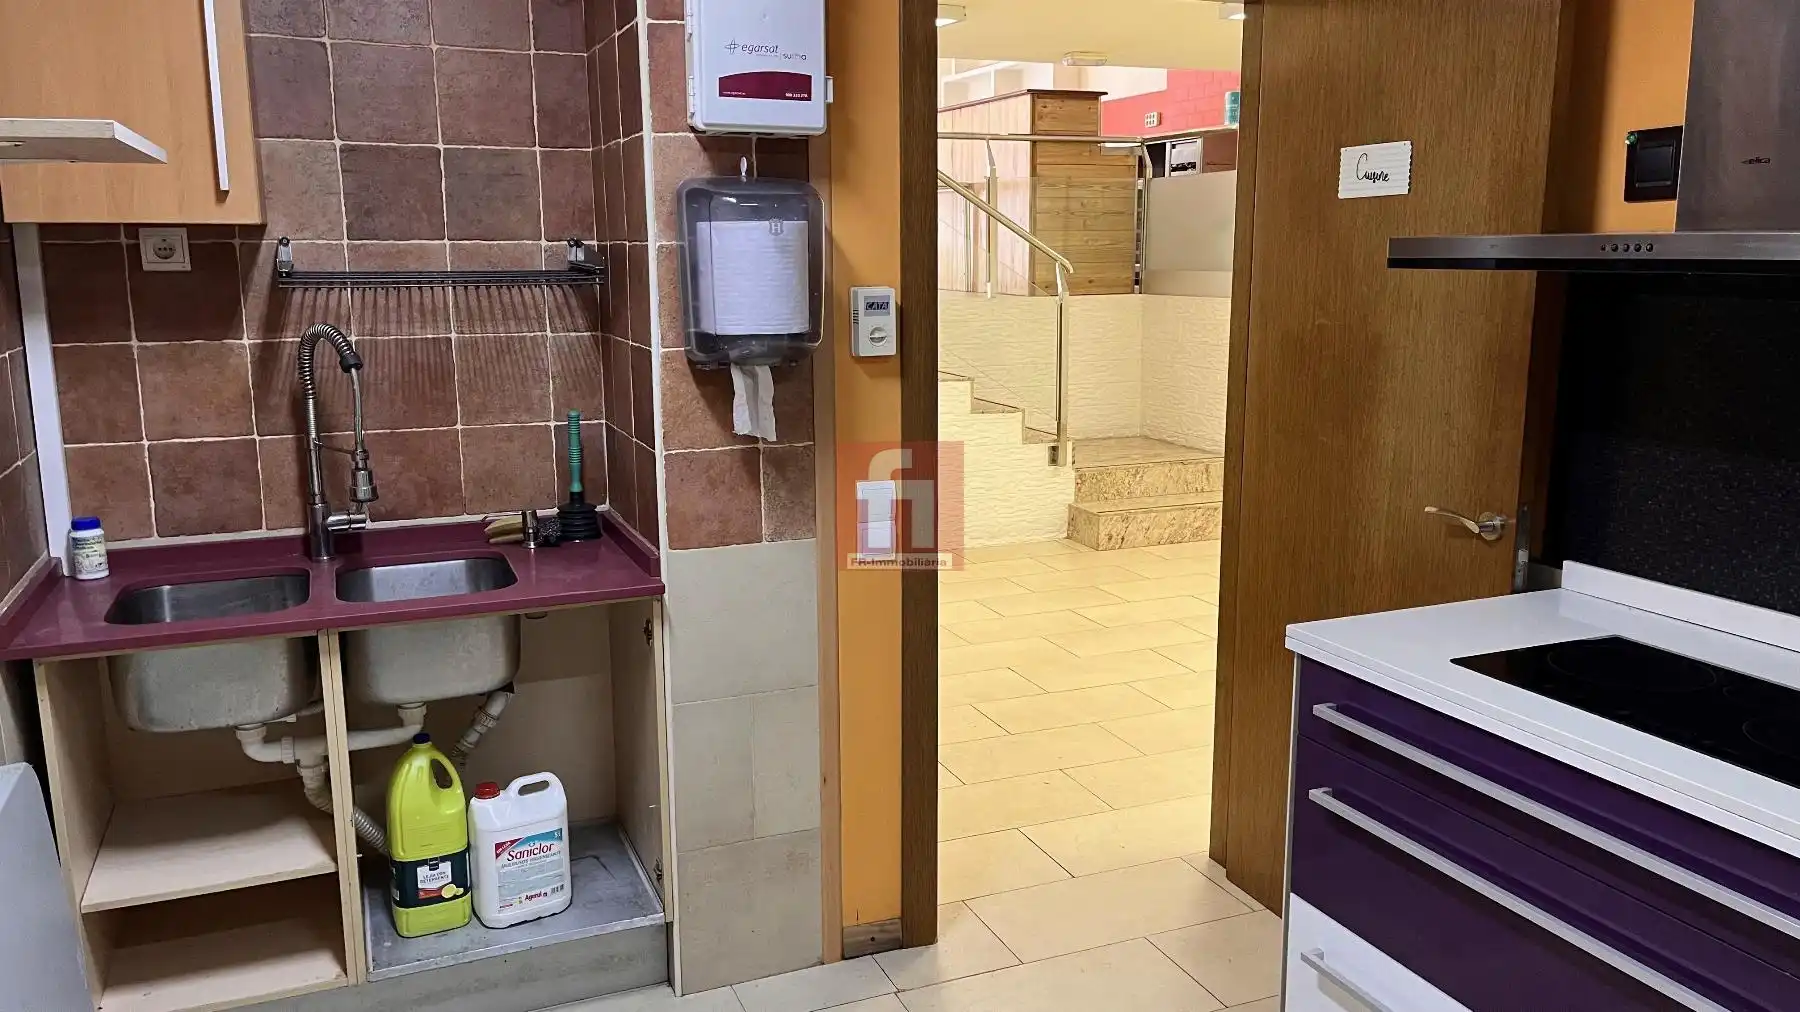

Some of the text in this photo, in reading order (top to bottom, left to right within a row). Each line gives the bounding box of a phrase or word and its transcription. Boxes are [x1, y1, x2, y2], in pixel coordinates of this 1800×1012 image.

[741, 44, 779, 54] egarsat
[1748, 156, 1771, 165] elica
[865, 301, 890, 311] CATA
[507, 842, 555, 862] Saniclor
